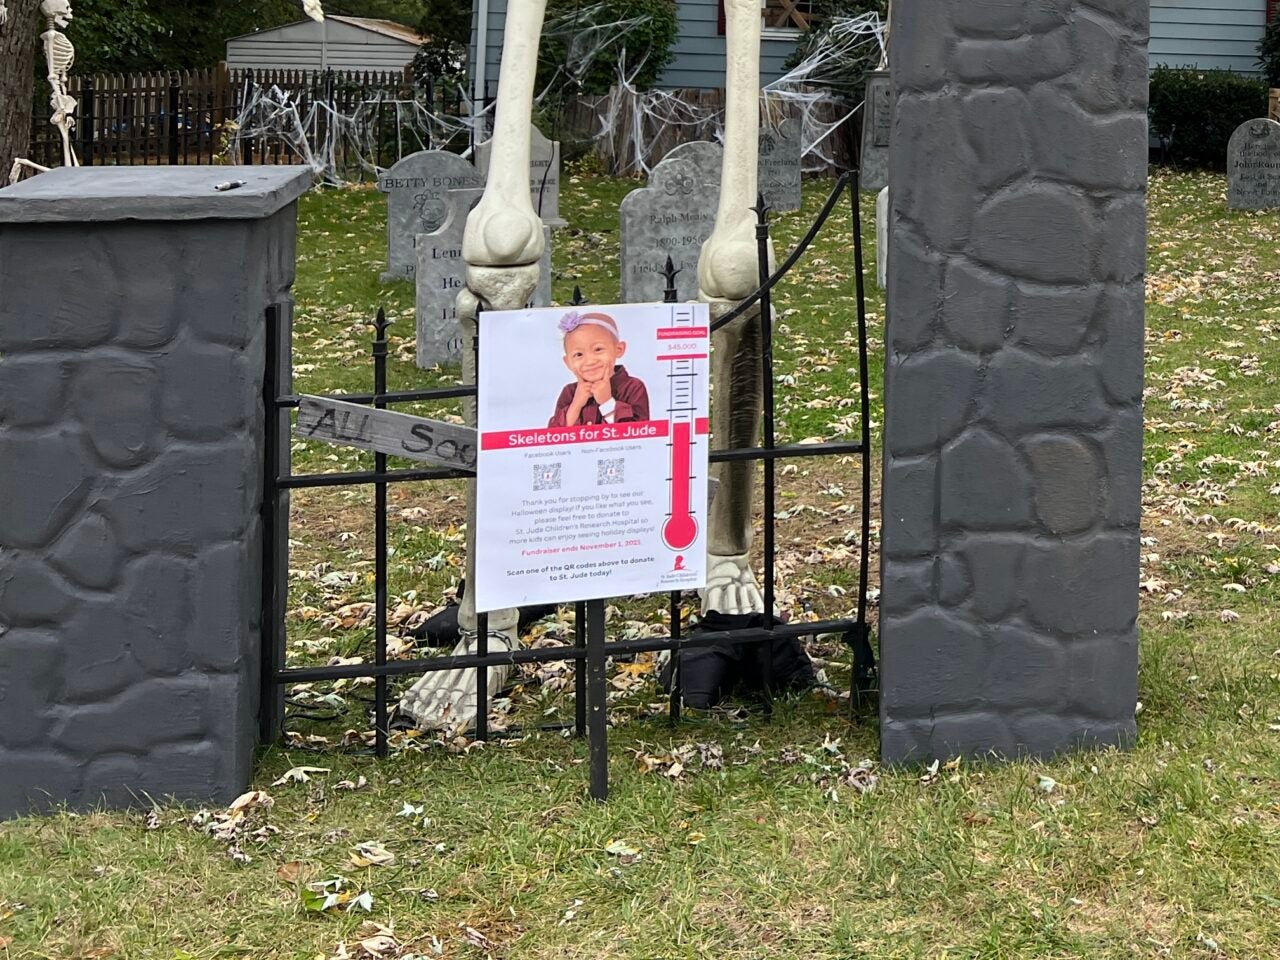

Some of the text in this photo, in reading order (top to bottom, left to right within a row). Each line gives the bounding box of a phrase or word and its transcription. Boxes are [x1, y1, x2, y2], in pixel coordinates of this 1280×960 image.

[385, 176, 479, 188] BETTY BONES
[650, 213, 677, 226] Ralph
[508, 424, 656, 446] Skeletons for St. Jude
[548, 506, 574, 514] display!
[534, 517, 557, 525] please
[596, 510, 620, 518] donate
[612, 518, 640, 526] Hospital
[601, 528, 626, 536] holiday
[521, 548, 560, 556] Fundraiser
[580, 542, 616, 551] November
[576, 562, 596, 570] codes
[598, 560, 620, 568] above
[630, 556, 655, 564] donate
[589, 568, 612, 577] today!
